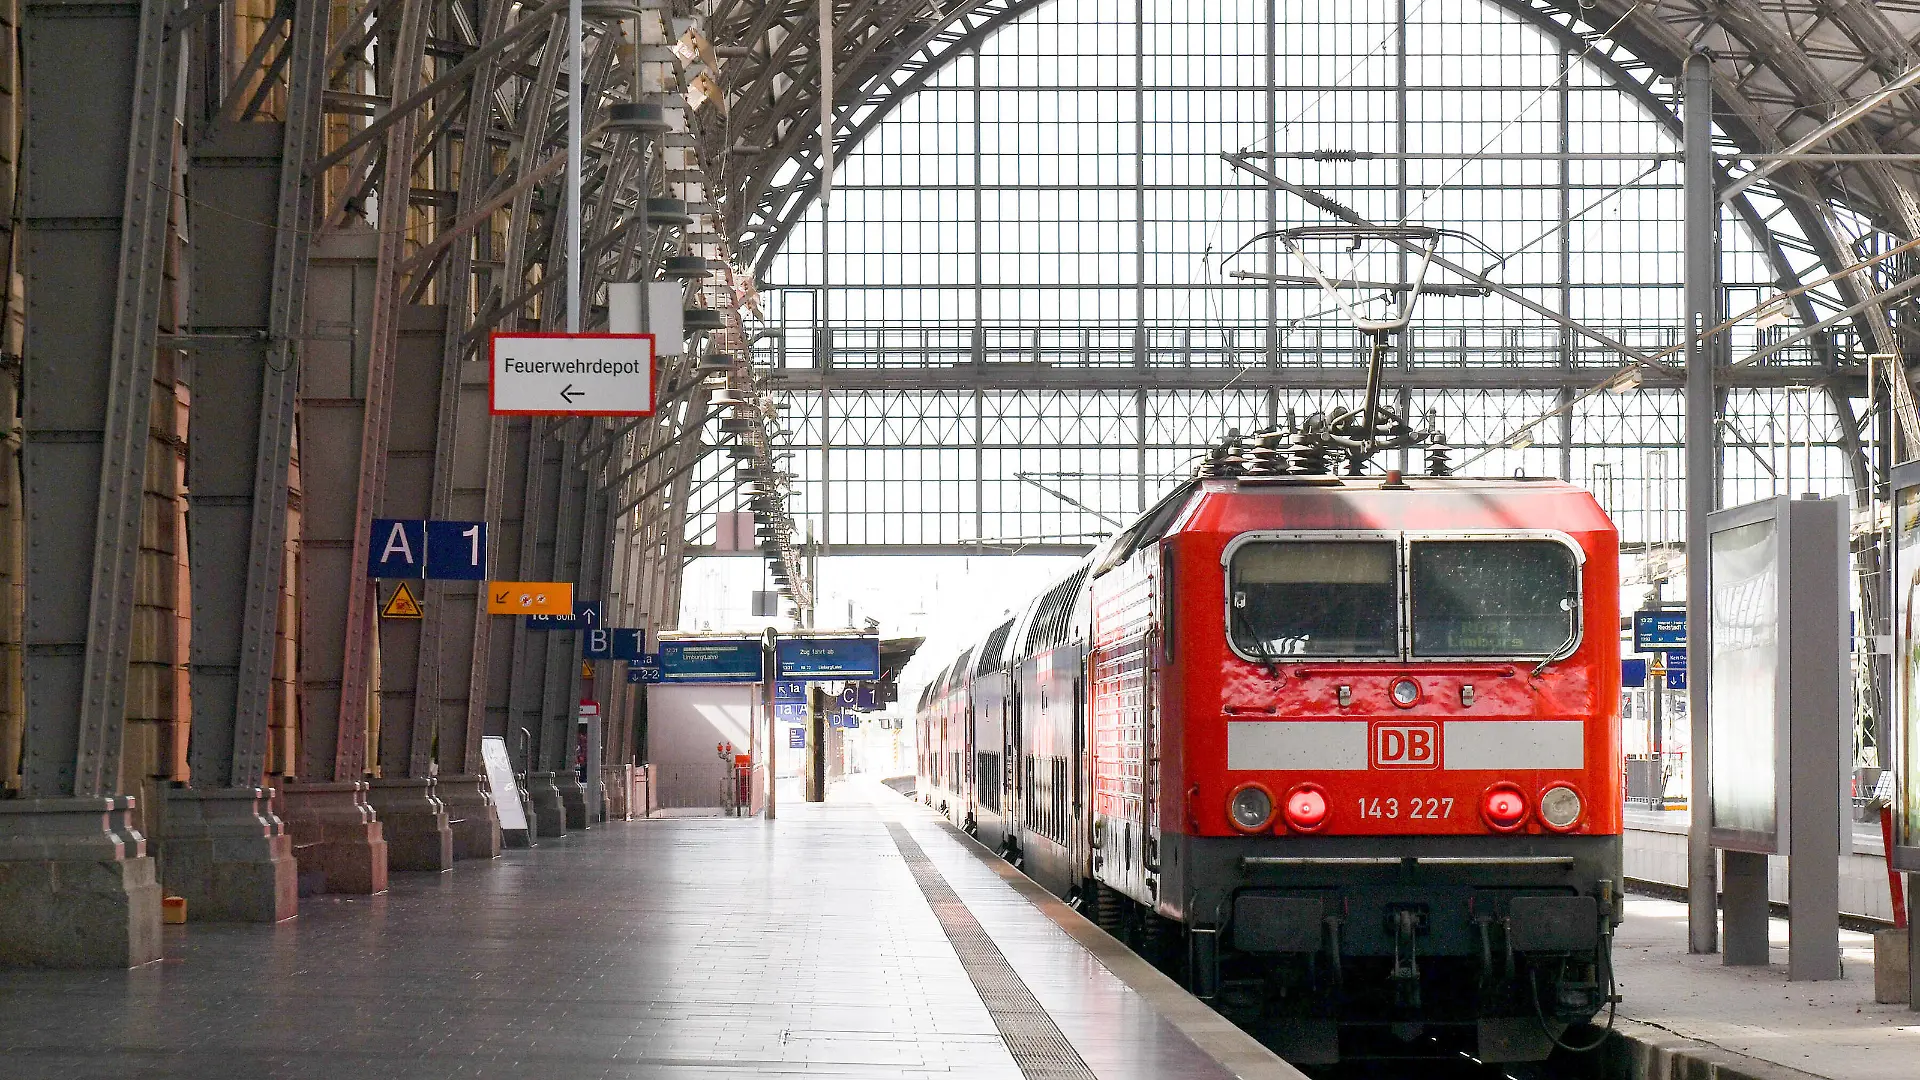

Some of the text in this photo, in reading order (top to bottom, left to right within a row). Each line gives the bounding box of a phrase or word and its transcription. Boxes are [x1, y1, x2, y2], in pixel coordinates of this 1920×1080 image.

[505, 358, 639, 377] Feuerwehrdepot
[380, 522, 414, 564] A
[462, 525, 479, 566] 1
[590, 629, 607, 652] B
[631, 630, 641, 653] 1
[641, 669, 660, 680] 2-2
[789, 683, 801, 693] 1a
[843, 688, 854, 703] C
[868, 689, 876, 704] 1
[833, 714, 841, 725] D
[850, 714, 856, 725] 1
[1381, 729, 1431, 761] DB
[1358, 797, 1454, 819] 143 227
